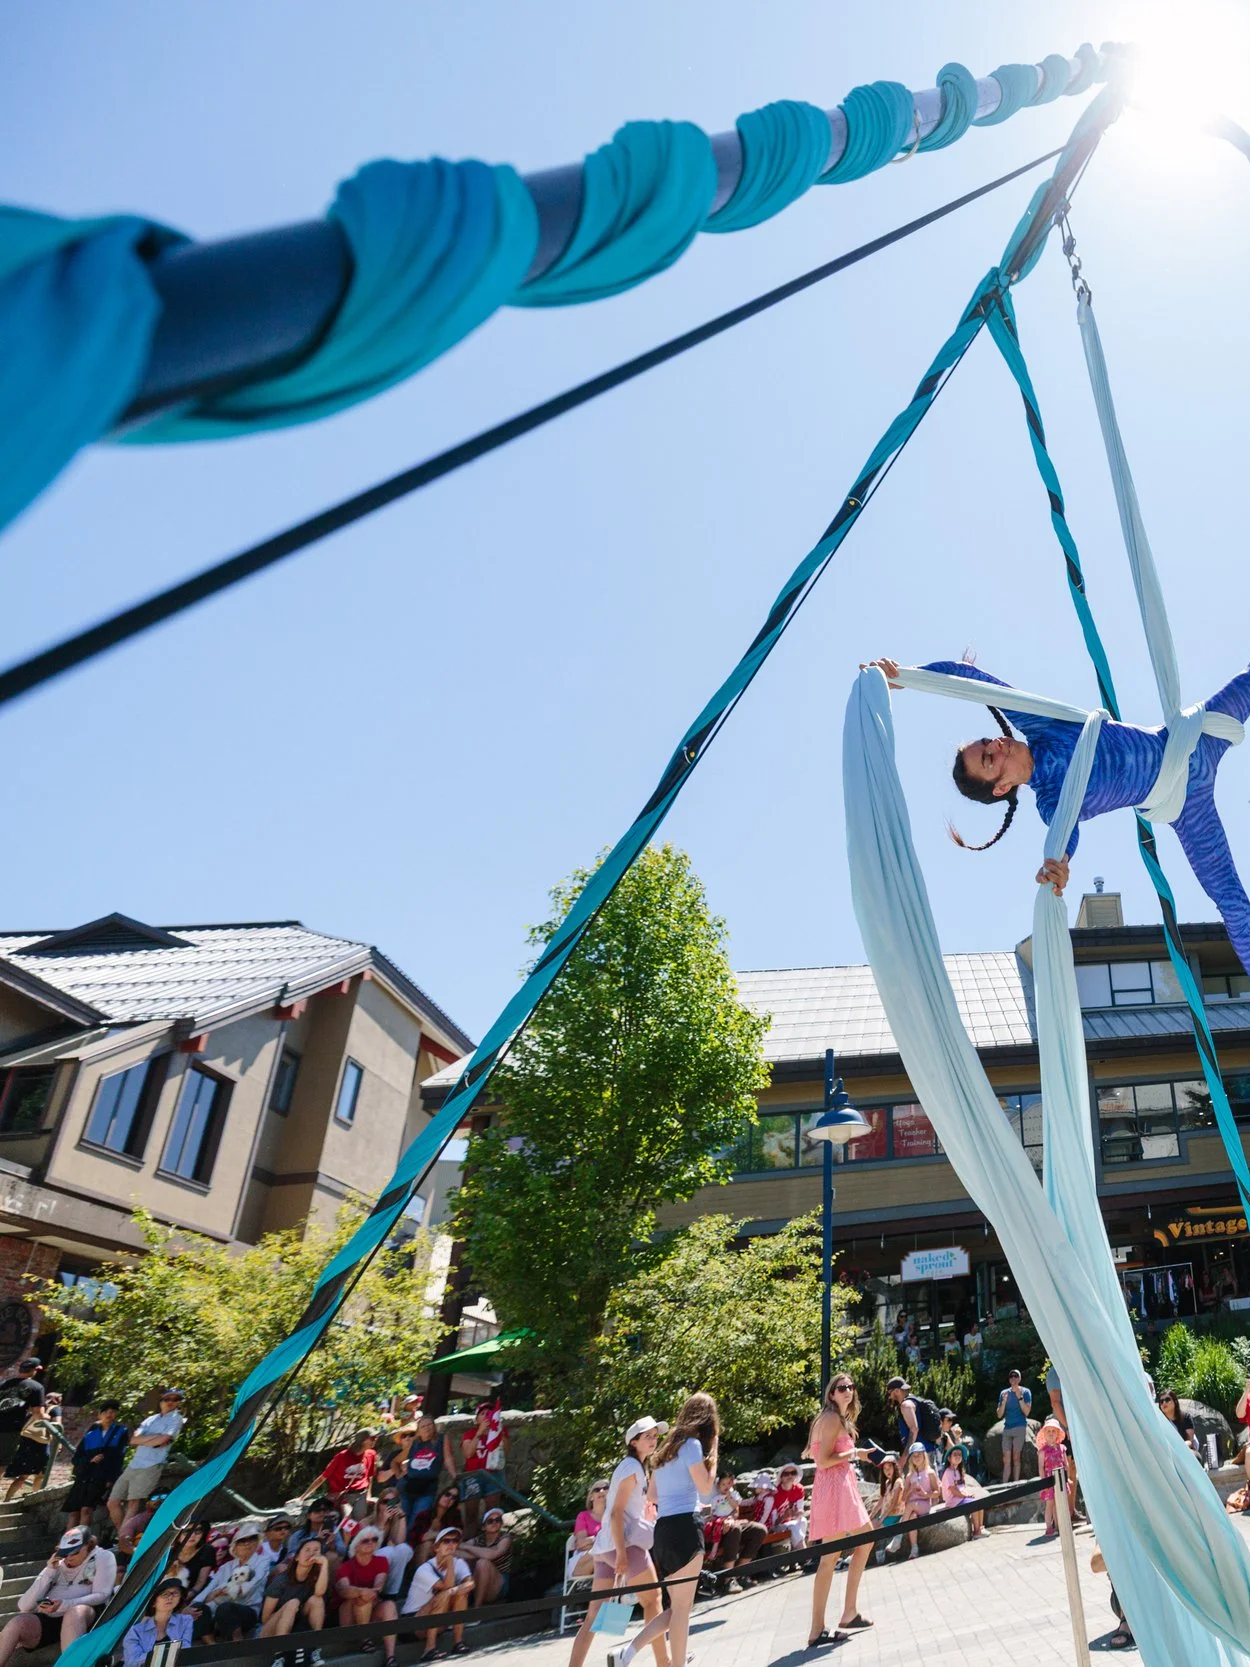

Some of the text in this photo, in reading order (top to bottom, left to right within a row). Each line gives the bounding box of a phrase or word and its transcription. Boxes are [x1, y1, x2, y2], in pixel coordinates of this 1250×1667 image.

[898, 1128, 927, 1137] Teacher
[1168, 1218, 1247, 1238] Vintage
[914, 1251, 950, 1264] naked
[915, 1261, 953, 1274] sprout
